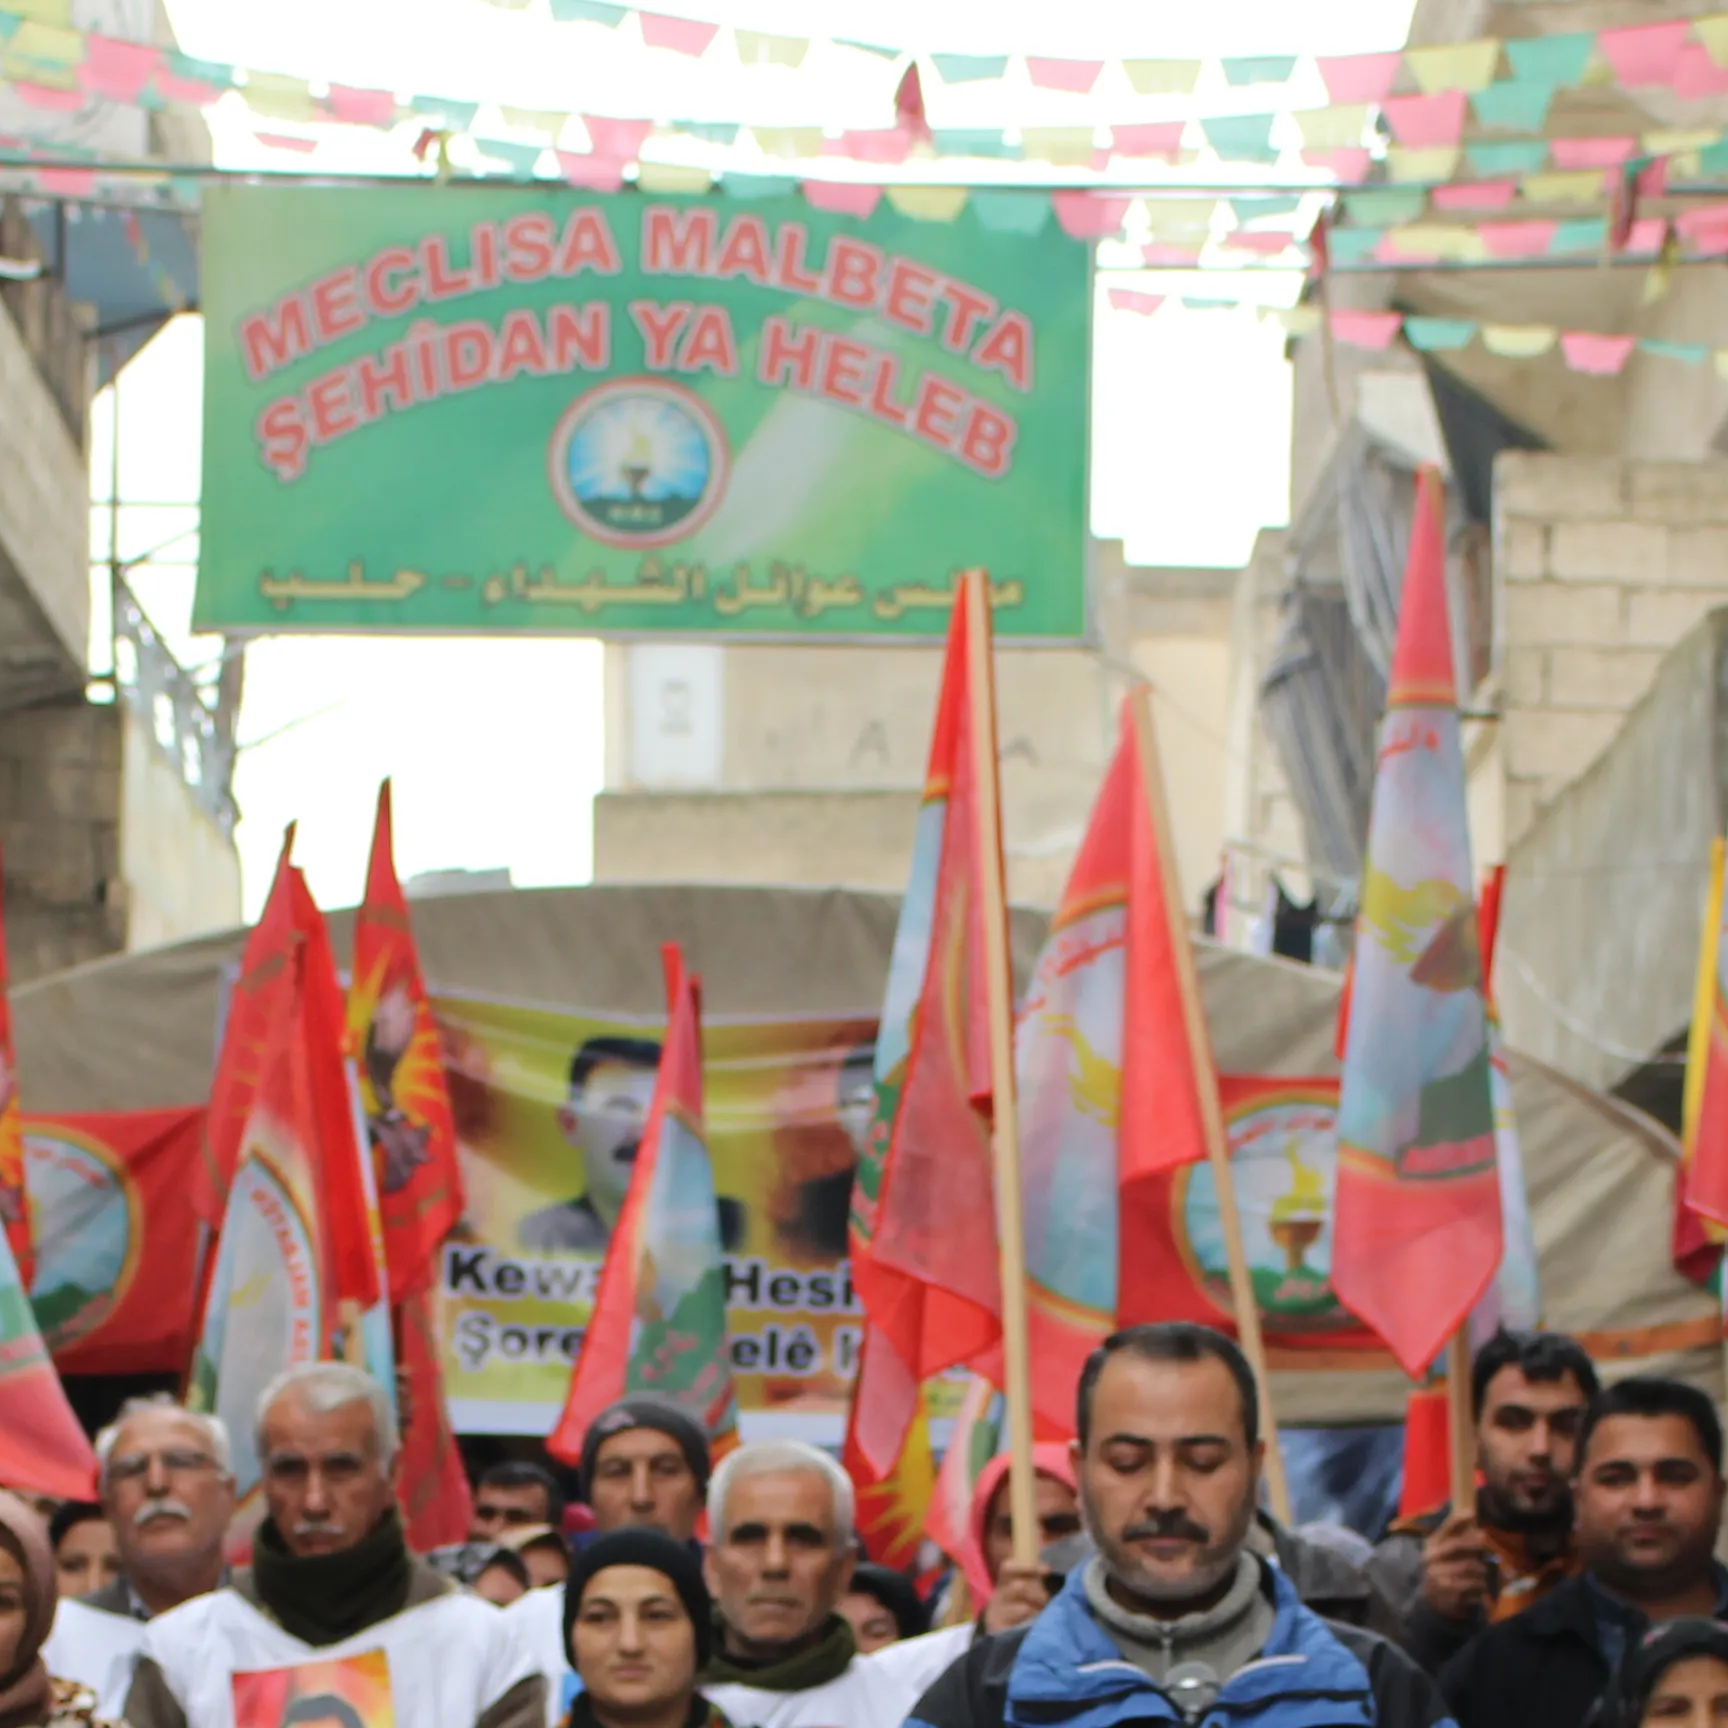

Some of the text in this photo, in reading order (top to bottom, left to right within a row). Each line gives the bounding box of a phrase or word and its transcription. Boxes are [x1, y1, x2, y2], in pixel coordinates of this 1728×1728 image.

[240, 205, 1035, 390] MECLISA MALBETA
[256, 302, 1017, 483] ŞEHÎDAN YA HELEB
[460, 1313, 589, 1368] Şore
[730, 1326, 816, 1372] elê
[723, 1261, 854, 1308] Hesi
